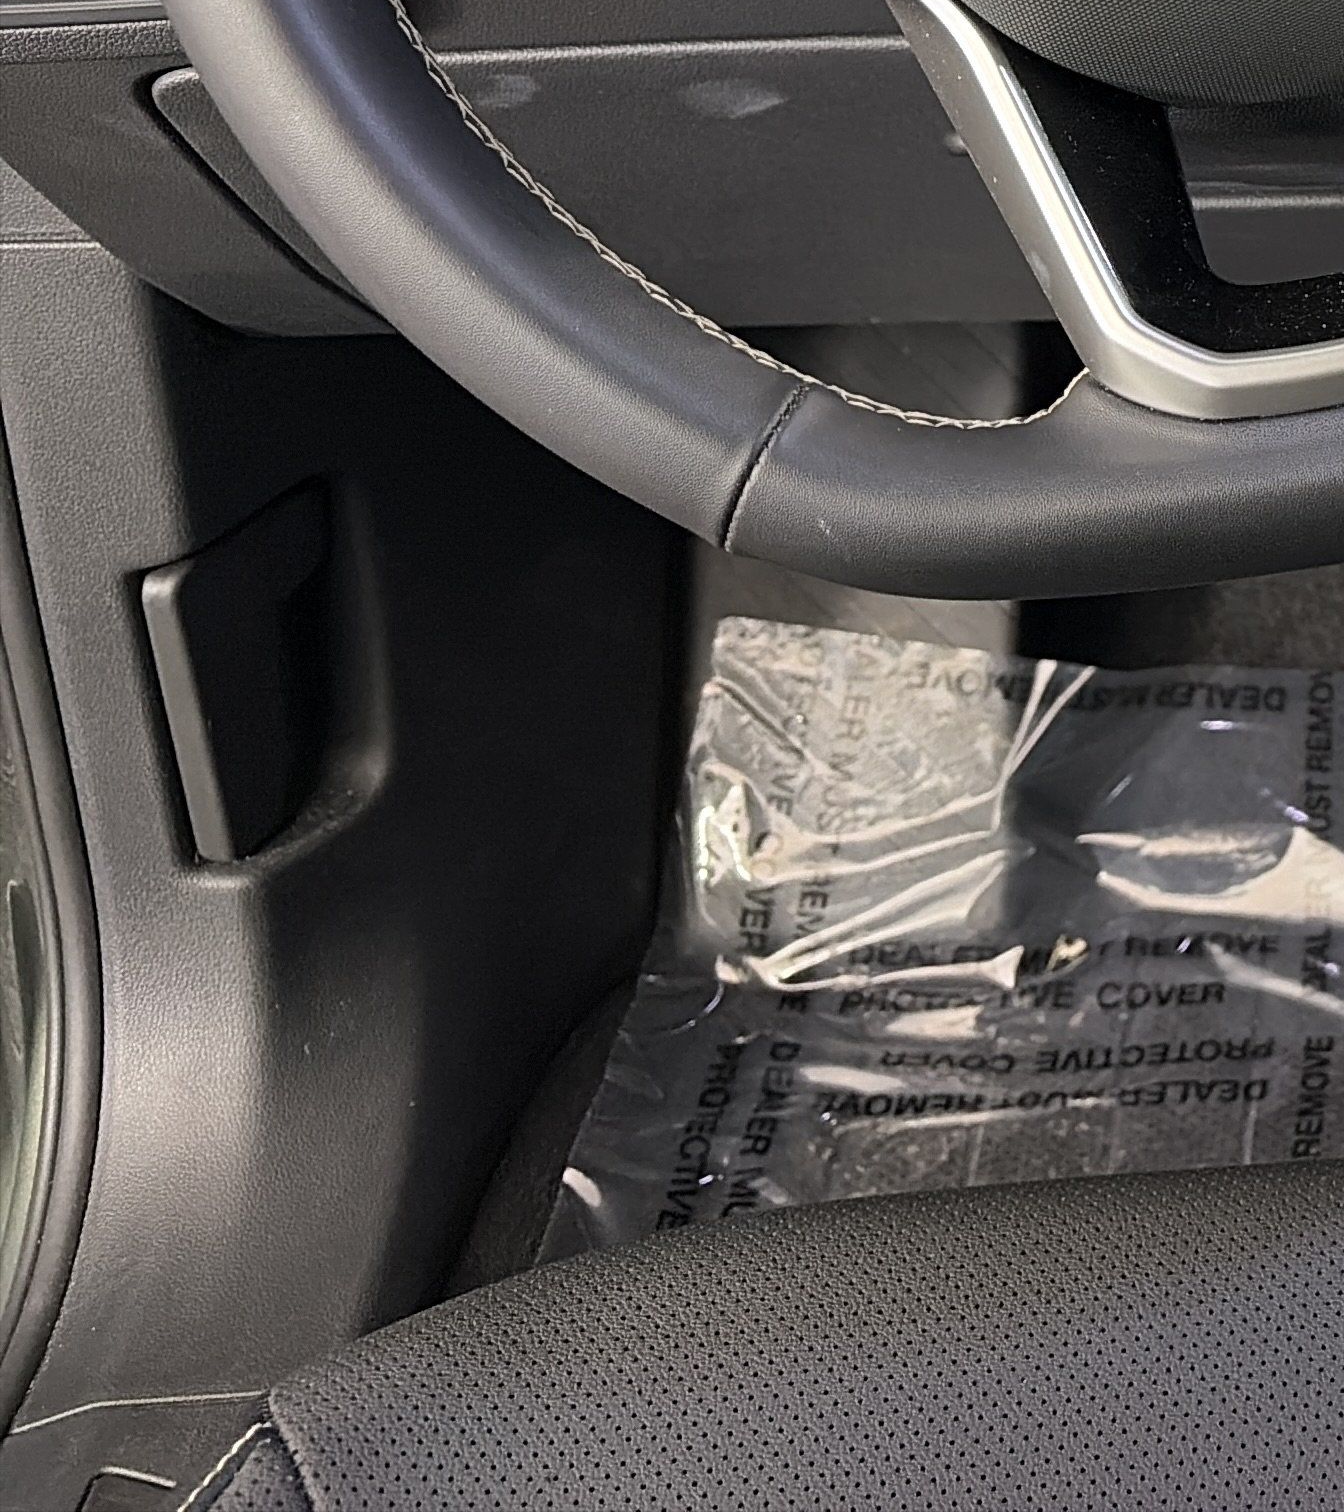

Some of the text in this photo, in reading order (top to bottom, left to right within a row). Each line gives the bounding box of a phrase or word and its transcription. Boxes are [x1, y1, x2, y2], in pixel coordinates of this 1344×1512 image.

[1096, 980, 1226, 1010] COVER
[1037, 1037, 1275, 1074] PROTECTIVE
[1117, 1079, 1270, 1107] DEALER
[1293, 1036, 1335, 1158] REMOVE
